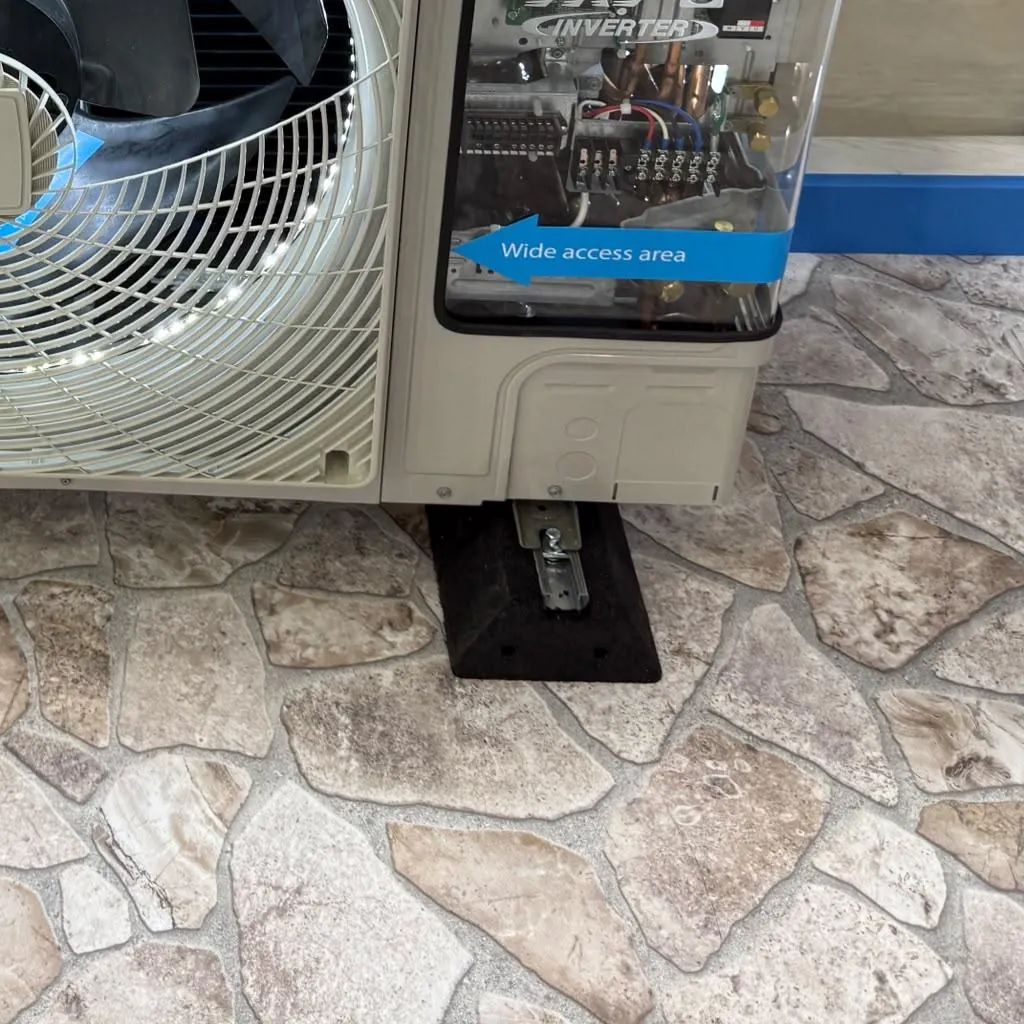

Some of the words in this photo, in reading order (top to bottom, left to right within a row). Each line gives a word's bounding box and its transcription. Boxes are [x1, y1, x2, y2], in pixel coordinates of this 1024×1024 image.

[551, 18, 690, 38] INVERTER
[501, 241, 557, 260] Wide
[564, 245, 633, 262] access
[639, 248, 687, 264] area
